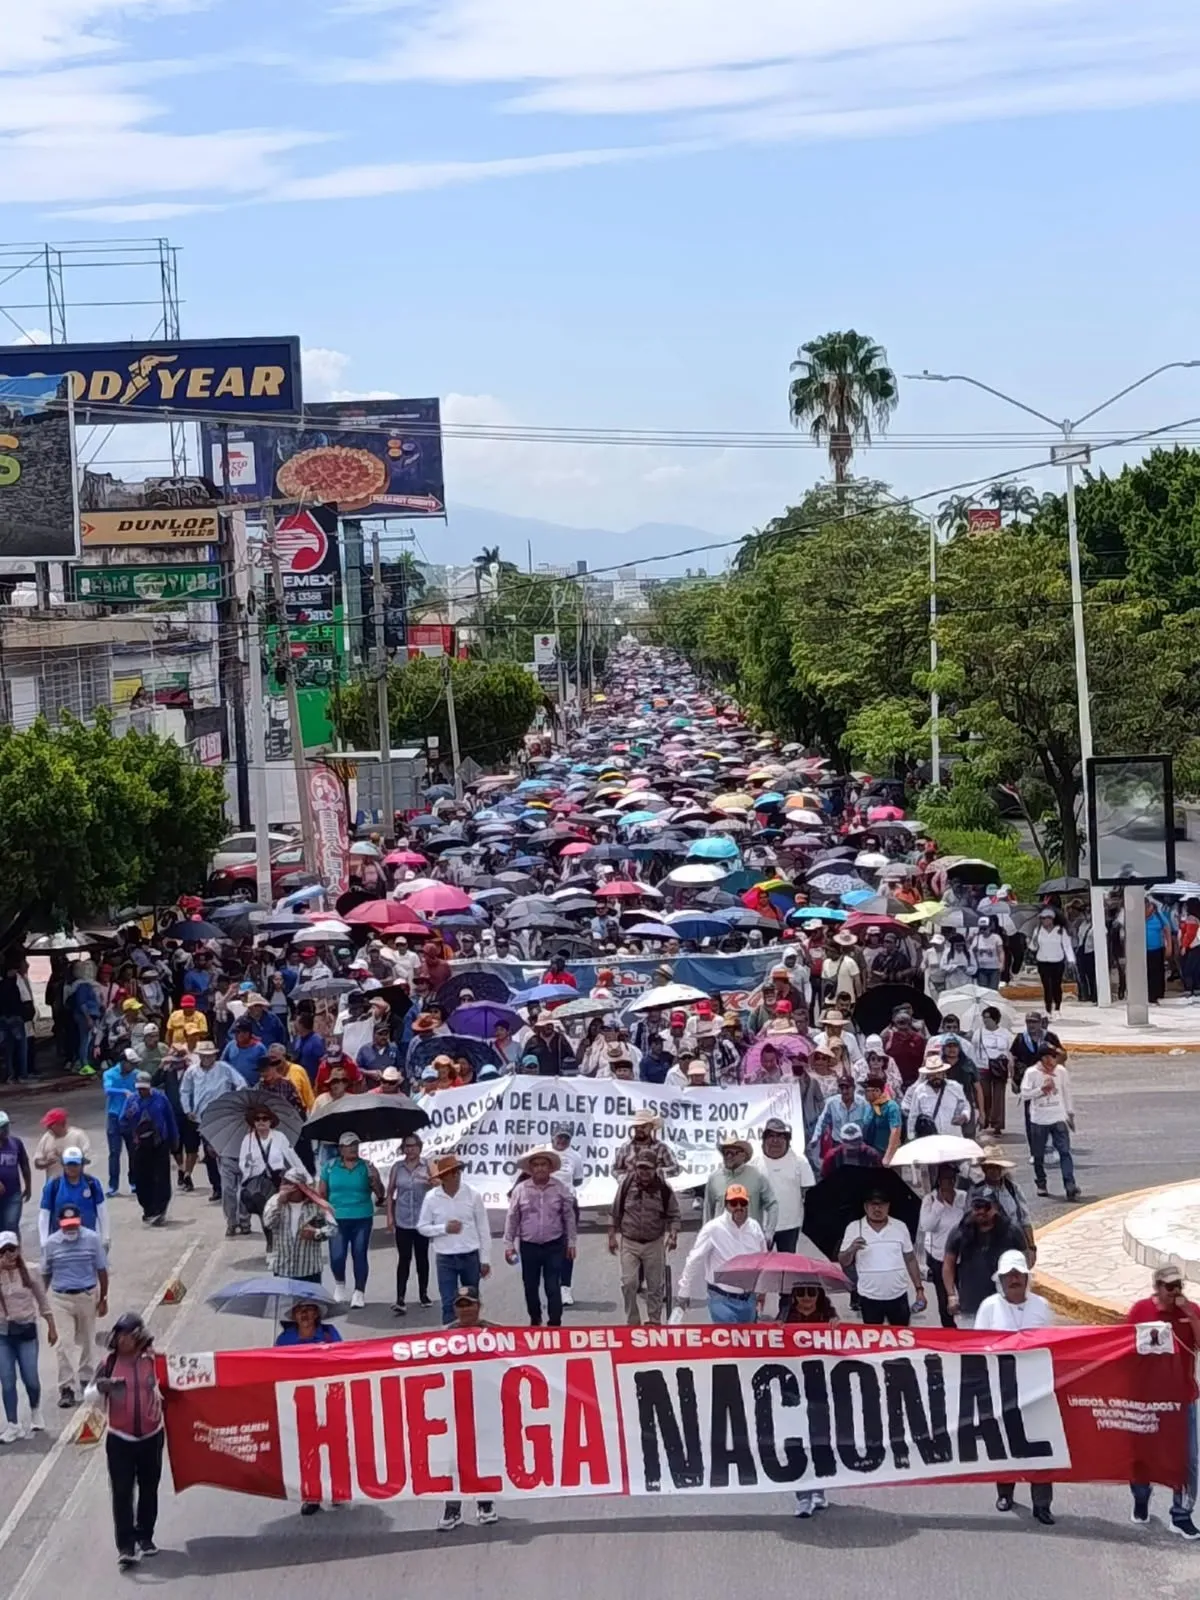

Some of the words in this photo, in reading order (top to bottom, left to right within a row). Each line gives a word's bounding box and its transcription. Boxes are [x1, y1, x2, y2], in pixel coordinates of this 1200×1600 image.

[157, 366, 285, 399] YEAR
[118, 517, 215, 532] DUNLOP
[171, 528, 215, 537] TIRES
[282, 574, 334, 588] EMEX
[422, 1092, 505, 1131] OGACIÓN
[510, 1091, 532, 1111] DE
[538, 1093, 560, 1112] LA
[566, 1095, 599, 1114] LEY
[604, 1096, 636, 1116] DEL
[642, 1099, 703, 1121] ISSSTE
[708, 1102, 748, 1122] 2007
[592, 1123, 689, 1142] EDUCIVA
[586, 1145, 609, 1159] NO
[392, 1328, 516, 1361] SECCIÓN
[524, 1330, 561, 1350] VII
[569, 1330, 623, 1349] DEL
[630, 1328, 786, 1349] SNTE-CNTE
[793, 1329, 916, 1350] CHIAPAS
[293, 1357, 611, 1502] HUELGA
[633, 1353, 1054, 1492] NACIONAL
